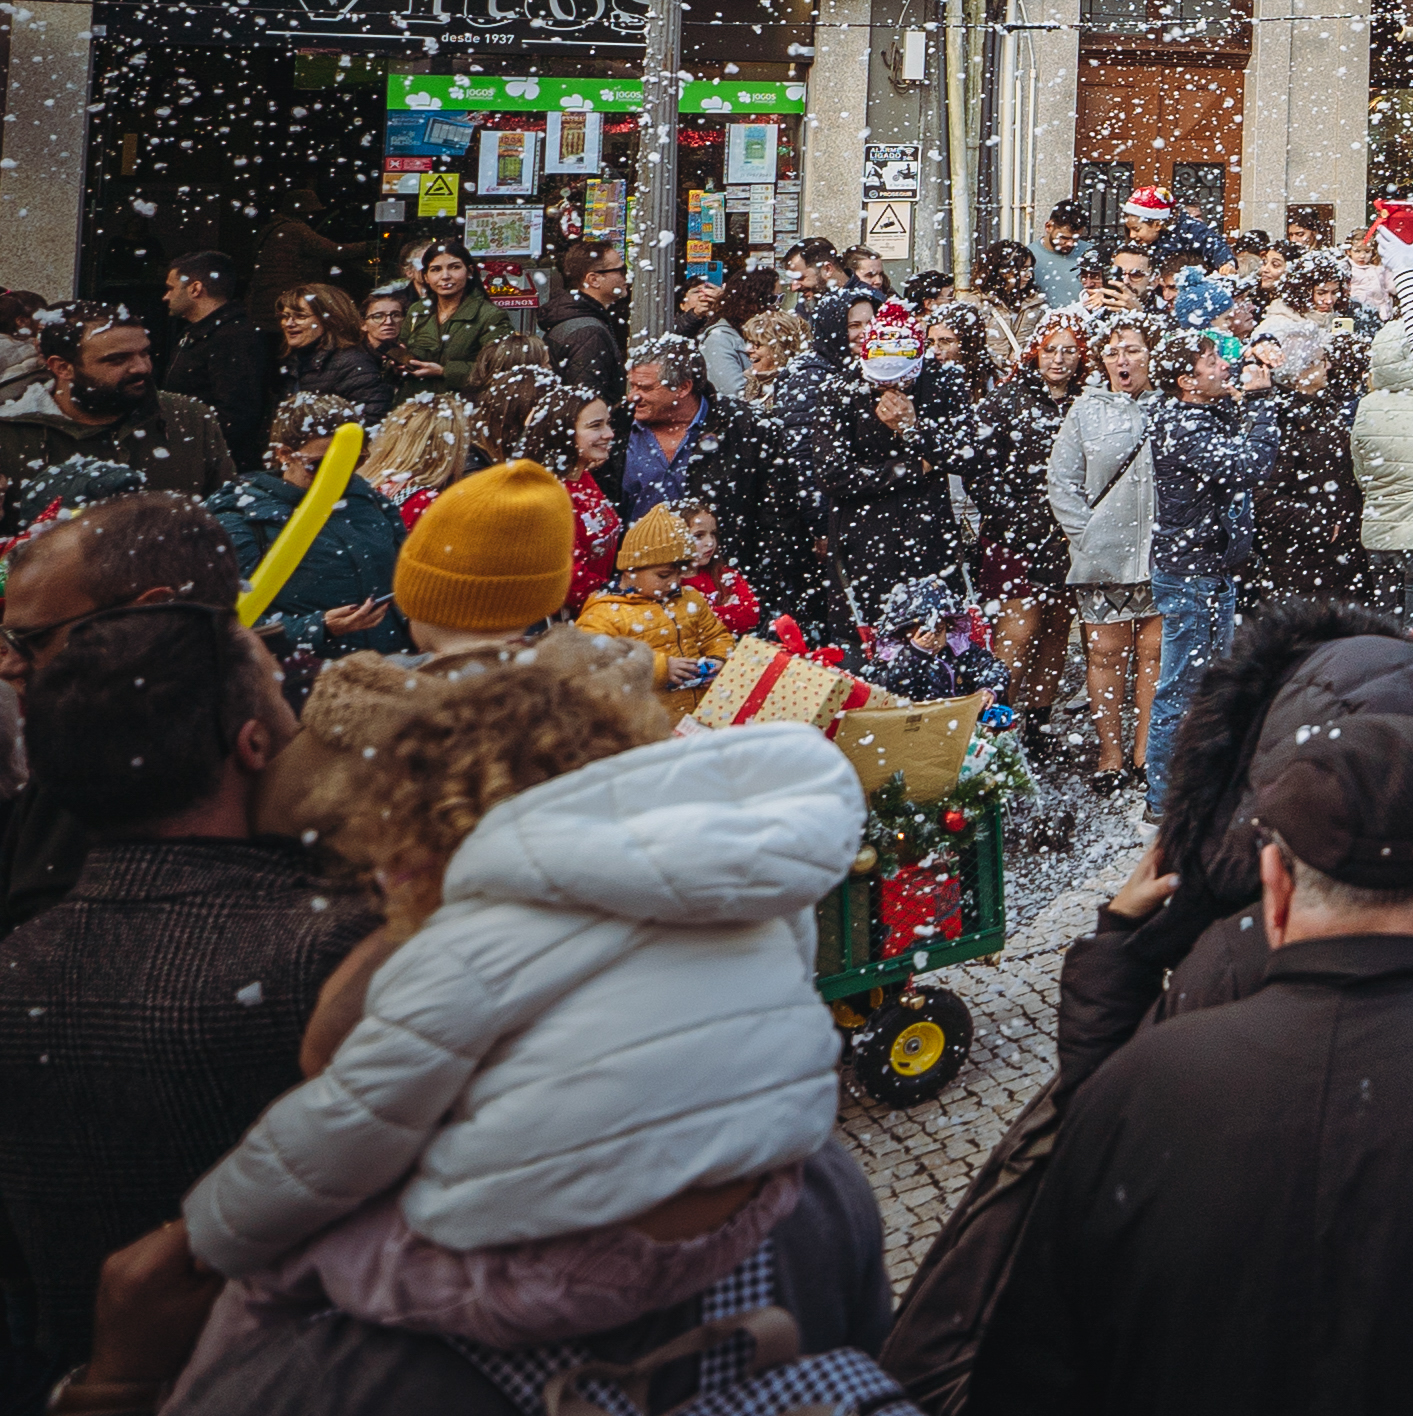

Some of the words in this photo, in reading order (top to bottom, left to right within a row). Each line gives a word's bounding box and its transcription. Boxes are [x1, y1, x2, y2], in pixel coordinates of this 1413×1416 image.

[440, 33, 481, 44] desde
[484, 33, 515, 45] 1937
[465, 88, 494, 97] JOGOS
[615, 90, 643, 99] JOGOS
[752, 92, 777, 101] JOGOS
[870, 152, 902, 160] LIGADO
[493, 298, 535, 306] TORINOX
